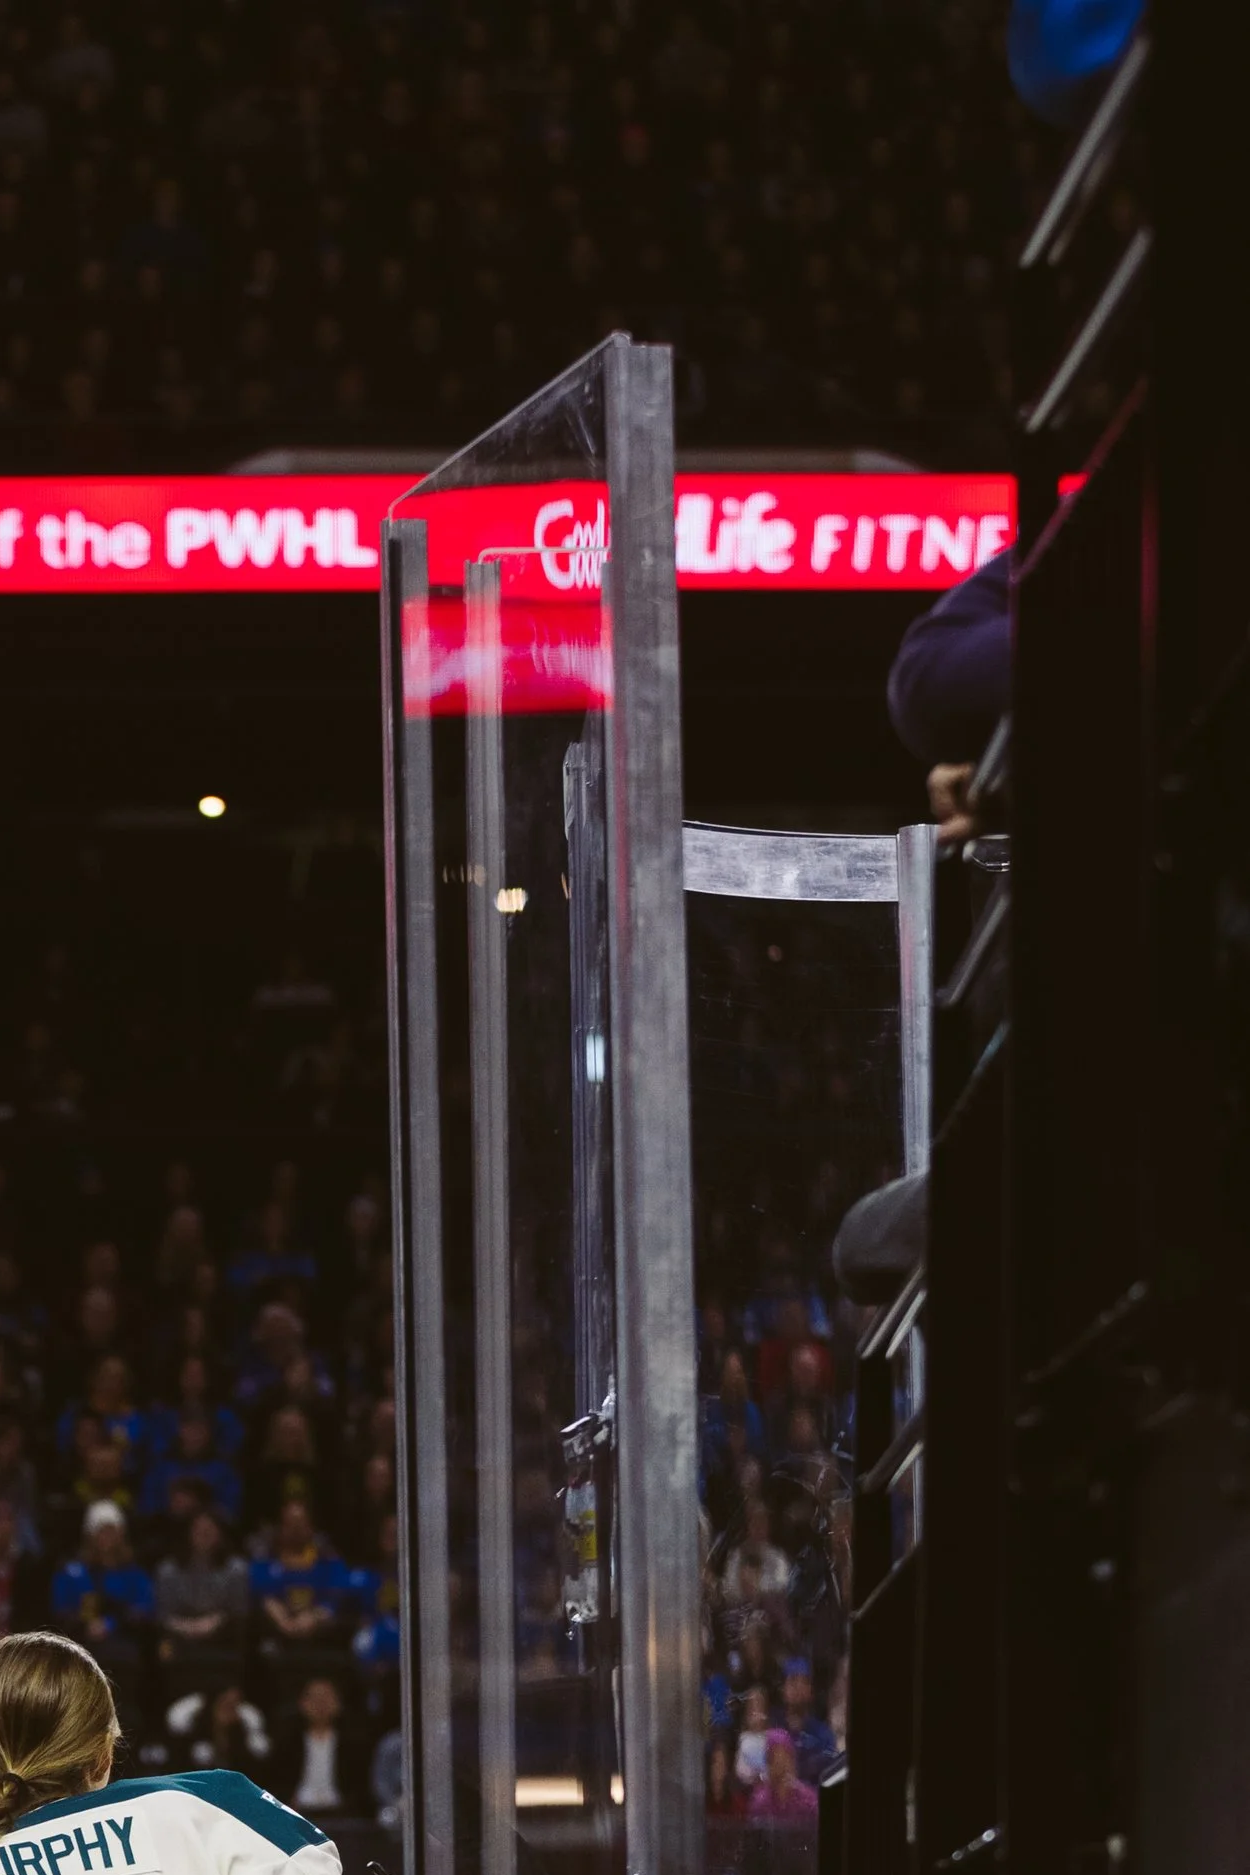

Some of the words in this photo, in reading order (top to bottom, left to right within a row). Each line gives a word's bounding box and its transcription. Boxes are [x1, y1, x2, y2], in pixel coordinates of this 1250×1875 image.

[36, 510, 152, 570] the
[166, 507, 379, 569] PWHL
[534, 498, 607, 590] Good
[674, 492, 796, 574] Life
